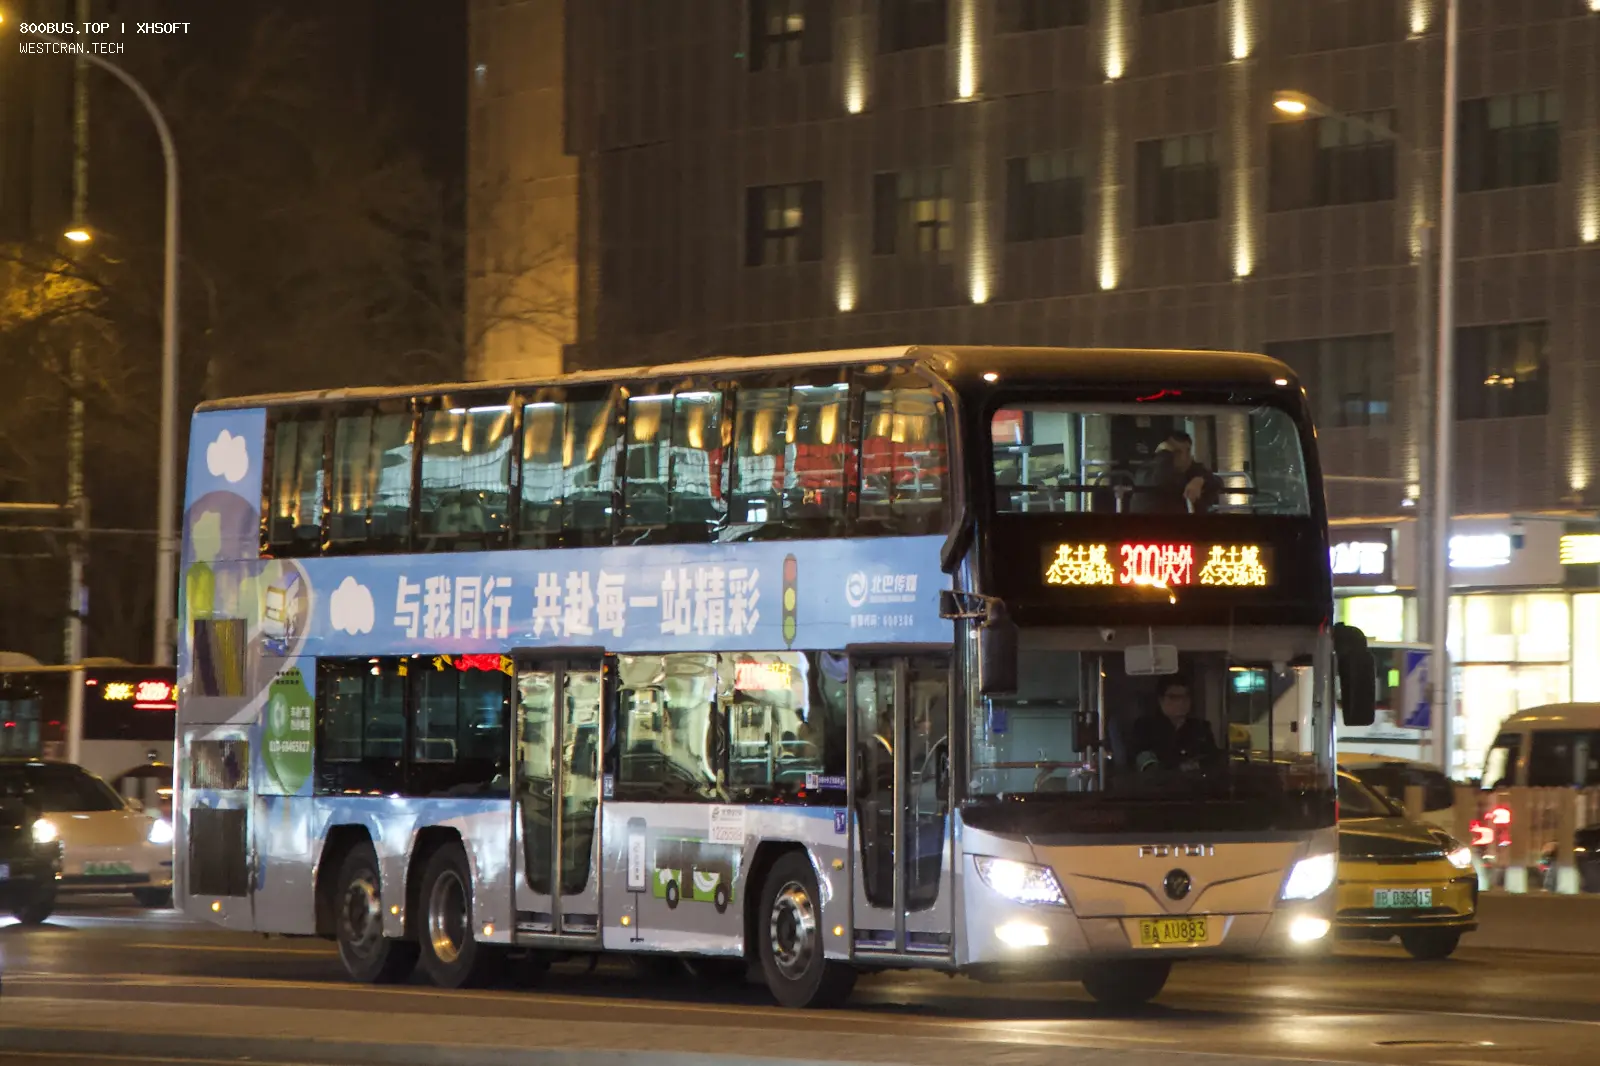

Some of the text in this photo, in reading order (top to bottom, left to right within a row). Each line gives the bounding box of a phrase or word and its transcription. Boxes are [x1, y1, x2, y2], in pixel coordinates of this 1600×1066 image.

[1046, 562, 1115, 585] 公交场站
[1199, 562, 1267, 586] 公交场站
[393, 566, 760, 639] 与我同行 共赴每一站精彩
